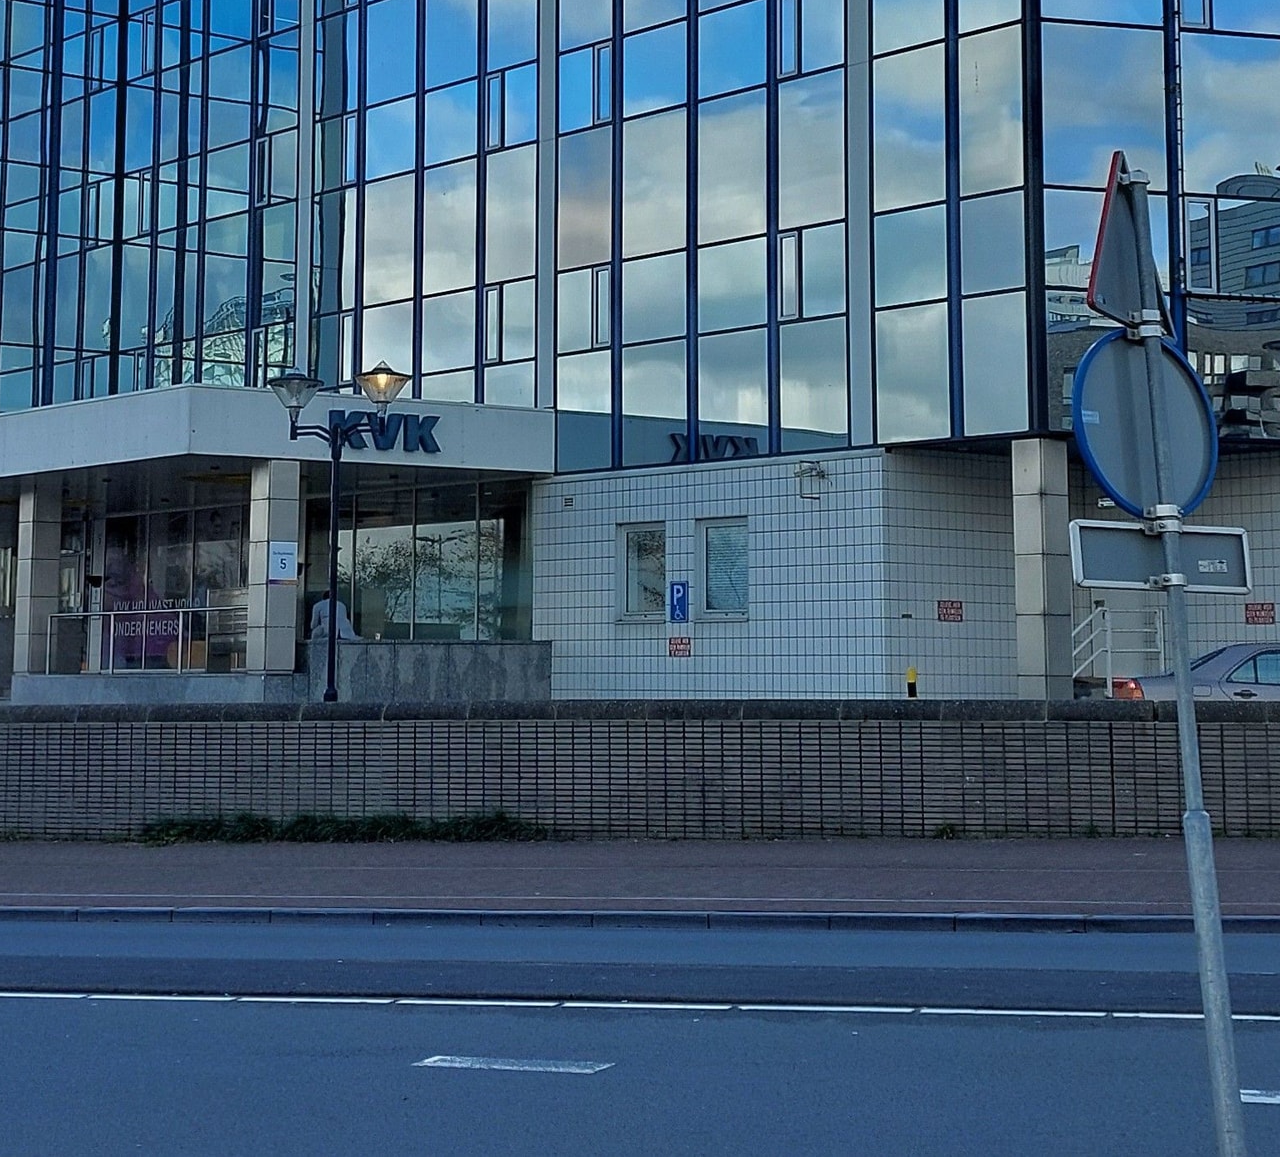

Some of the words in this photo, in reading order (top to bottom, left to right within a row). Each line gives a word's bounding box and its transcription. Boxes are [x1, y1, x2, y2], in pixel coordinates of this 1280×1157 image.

[329, 409, 441, 452] KVK
[280, 558, 287, 569] 5
[673, 585, 684, 605] P
